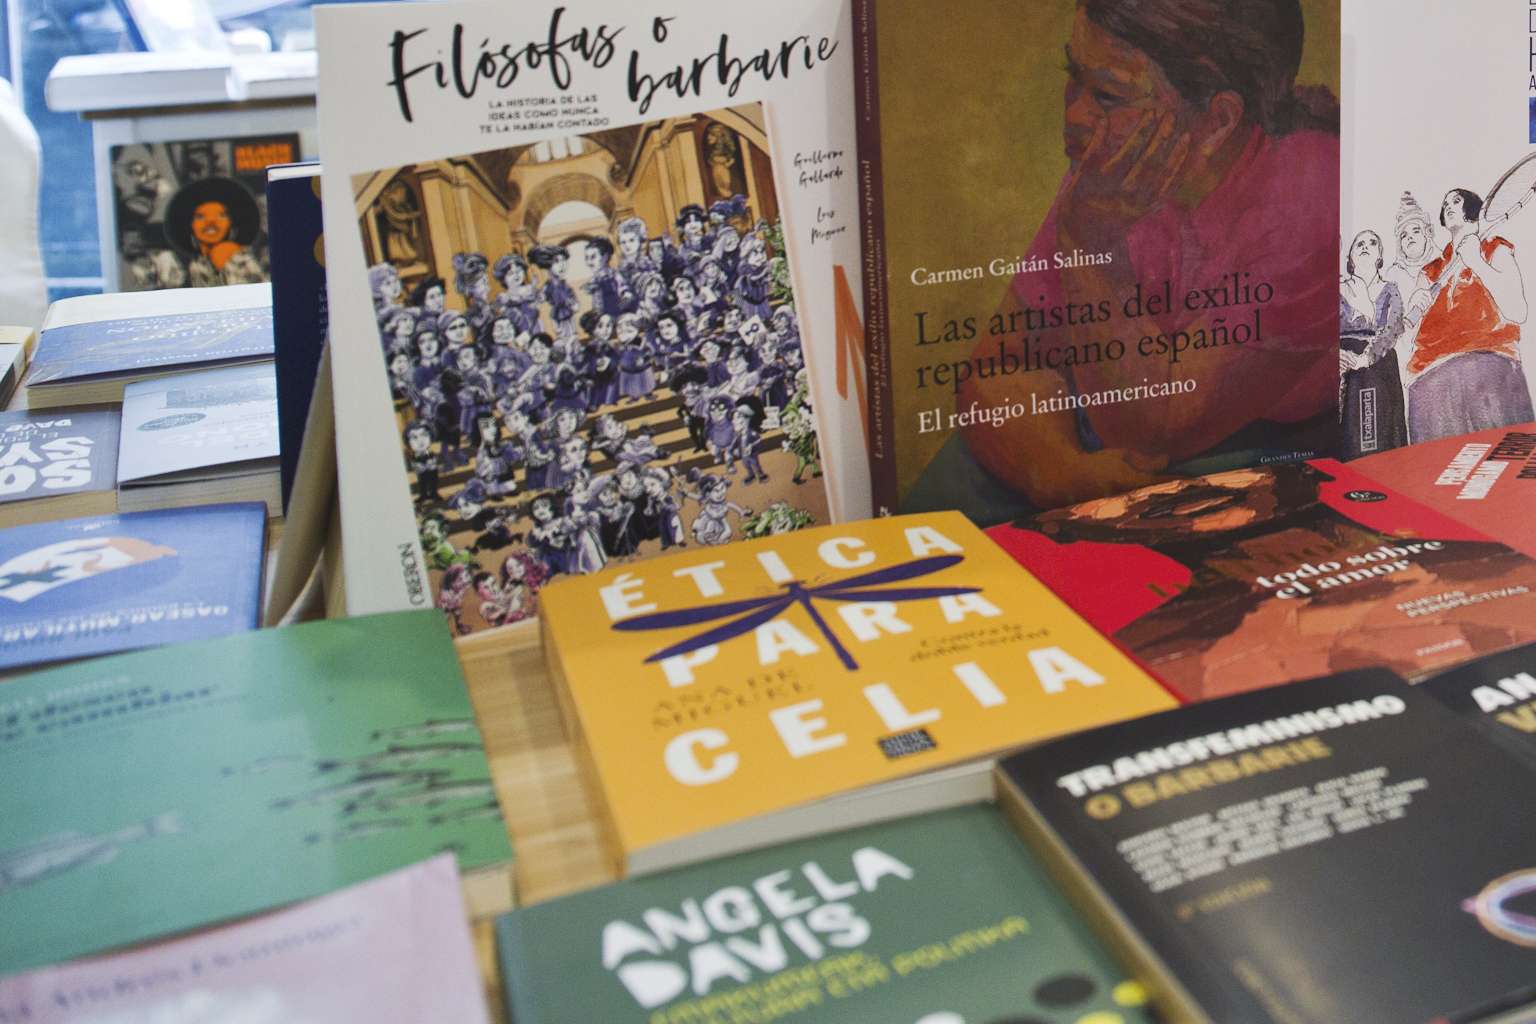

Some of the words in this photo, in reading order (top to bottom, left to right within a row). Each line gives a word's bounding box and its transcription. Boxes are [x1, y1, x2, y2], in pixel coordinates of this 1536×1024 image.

[386, 6, 626, 123] Filósofas
[627, 31, 840, 115] barbarie
[480, 124, 492, 134] TE
[496, 124, 509, 133] LA
[557, 117, 609, 129] CONTADO
[488, 100, 503, 109] LA
[506, 96, 556, 107] HISTORIA
[560, 95, 574, 105] DE
[577, 94, 597, 104] LAS
[488, 111, 521, 121] IDEAS
[523, 109, 558, 119] COMO
[861, 160, 875, 216] español
[864, 219, 878, 306] republicano
[910, 262, 984, 287] Carmen
[989, 254, 1049, 280] Gaitán
[1053, 248, 1113, 270] Salinas
[868, 311, 880, 351] exilio
[914, 311, 978, 346] Las
[989, 295, 1112, 338] artistas
[1123, 280, 1172, 318] del
[1184, 272, 1275, 312] exilio
[869, 353, 881, 376] del
[916, 334, 1126, 396] republicano
[1137, 309, 1263, 364] español
[870, 381, 882, 428] artistas
[918, 409, 942, 434] El
[948, 391, 1025, 428] refugio
[1030, 377, 1198, 416] latinoamericano
[1363, 391, 1374, 440] txalaparta
[872, 433, 884, 459] Las
[599, 525, 966, 622] ÉTICA
[1256, 560, 1342, 589] todo
[1346, 540, 1446, 567] sobre
[1275, 579, 1312, 600] el
[1316, 559, 1410, 589] amor
[1396, 590, 1467, 612] NUEVAS
[1406, 585, 1530, 618] PERSPECTIVAS
[657, 593, 1003, 689] PARA
[662, 645, 1107, 788] CELIA
[1056, 694, 1407, 798] TRANSFEMINISMO
[1085, 791, 1122, 820] O
[1122, 737, 1334, 809] BARBARIE
[601, 845, 916, 970] ANGELA
[618, 901, 872, 1009] DAVIS
